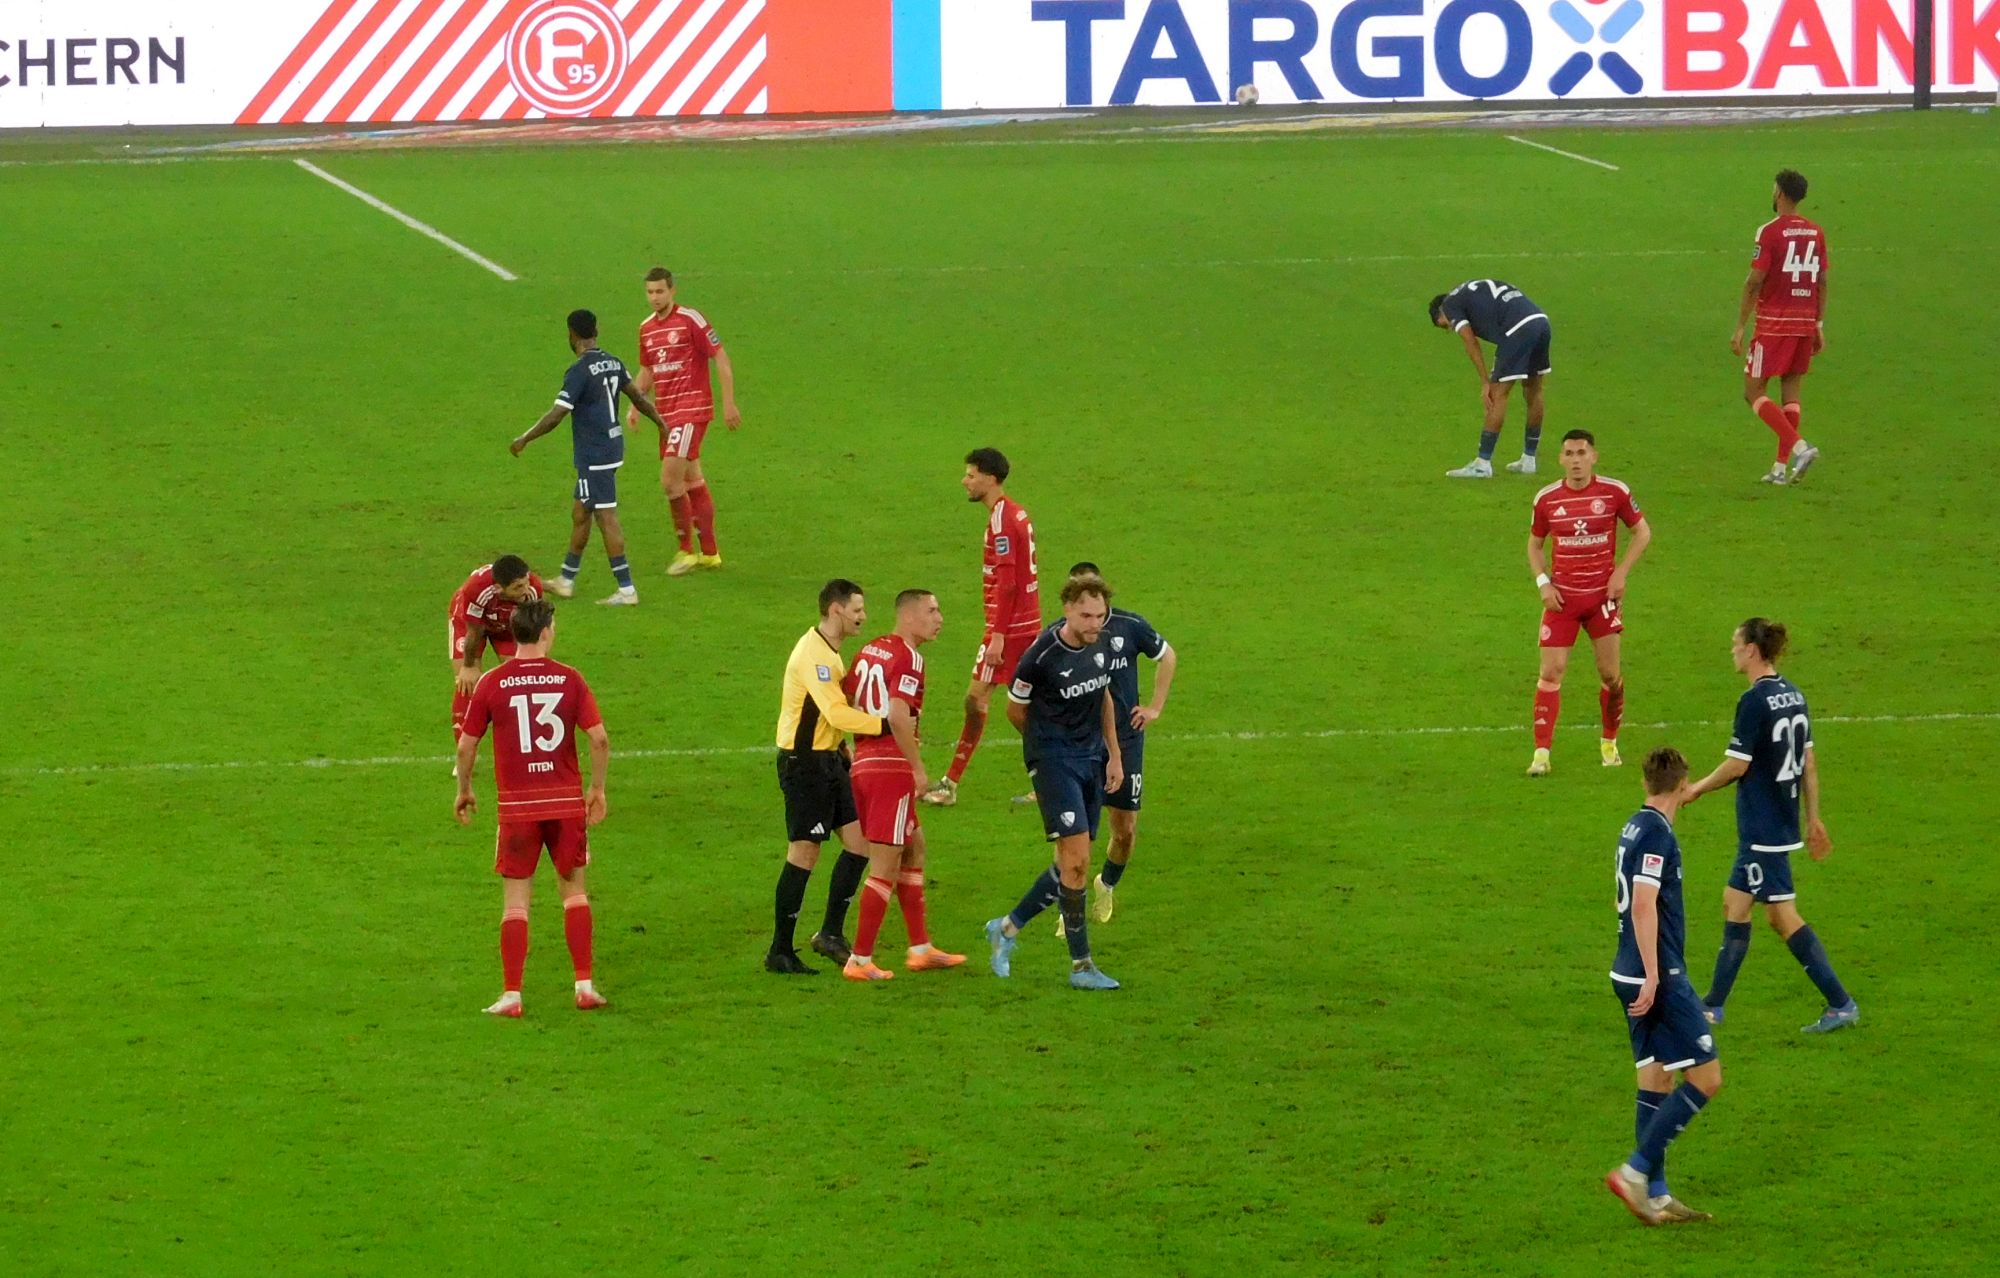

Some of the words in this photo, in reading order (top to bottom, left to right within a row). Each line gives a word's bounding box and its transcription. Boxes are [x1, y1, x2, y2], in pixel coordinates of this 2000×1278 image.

[1031, 0, 1533, 105] TARGO
[1662, 0, 2000, 91] BANK
[567, 64, 597, 84] 95
[1782, 241, 1820, 283] 44
[499, 675, 567, 689] DÜSSELDORF
[855, 658, 889, 718] 20
[509, 692, 565, 754] 13
[528, 761, 554, 773] ITTEN
[1772, 714, 1809, 782] 20
[1130, 773, 1142, 796] 19
